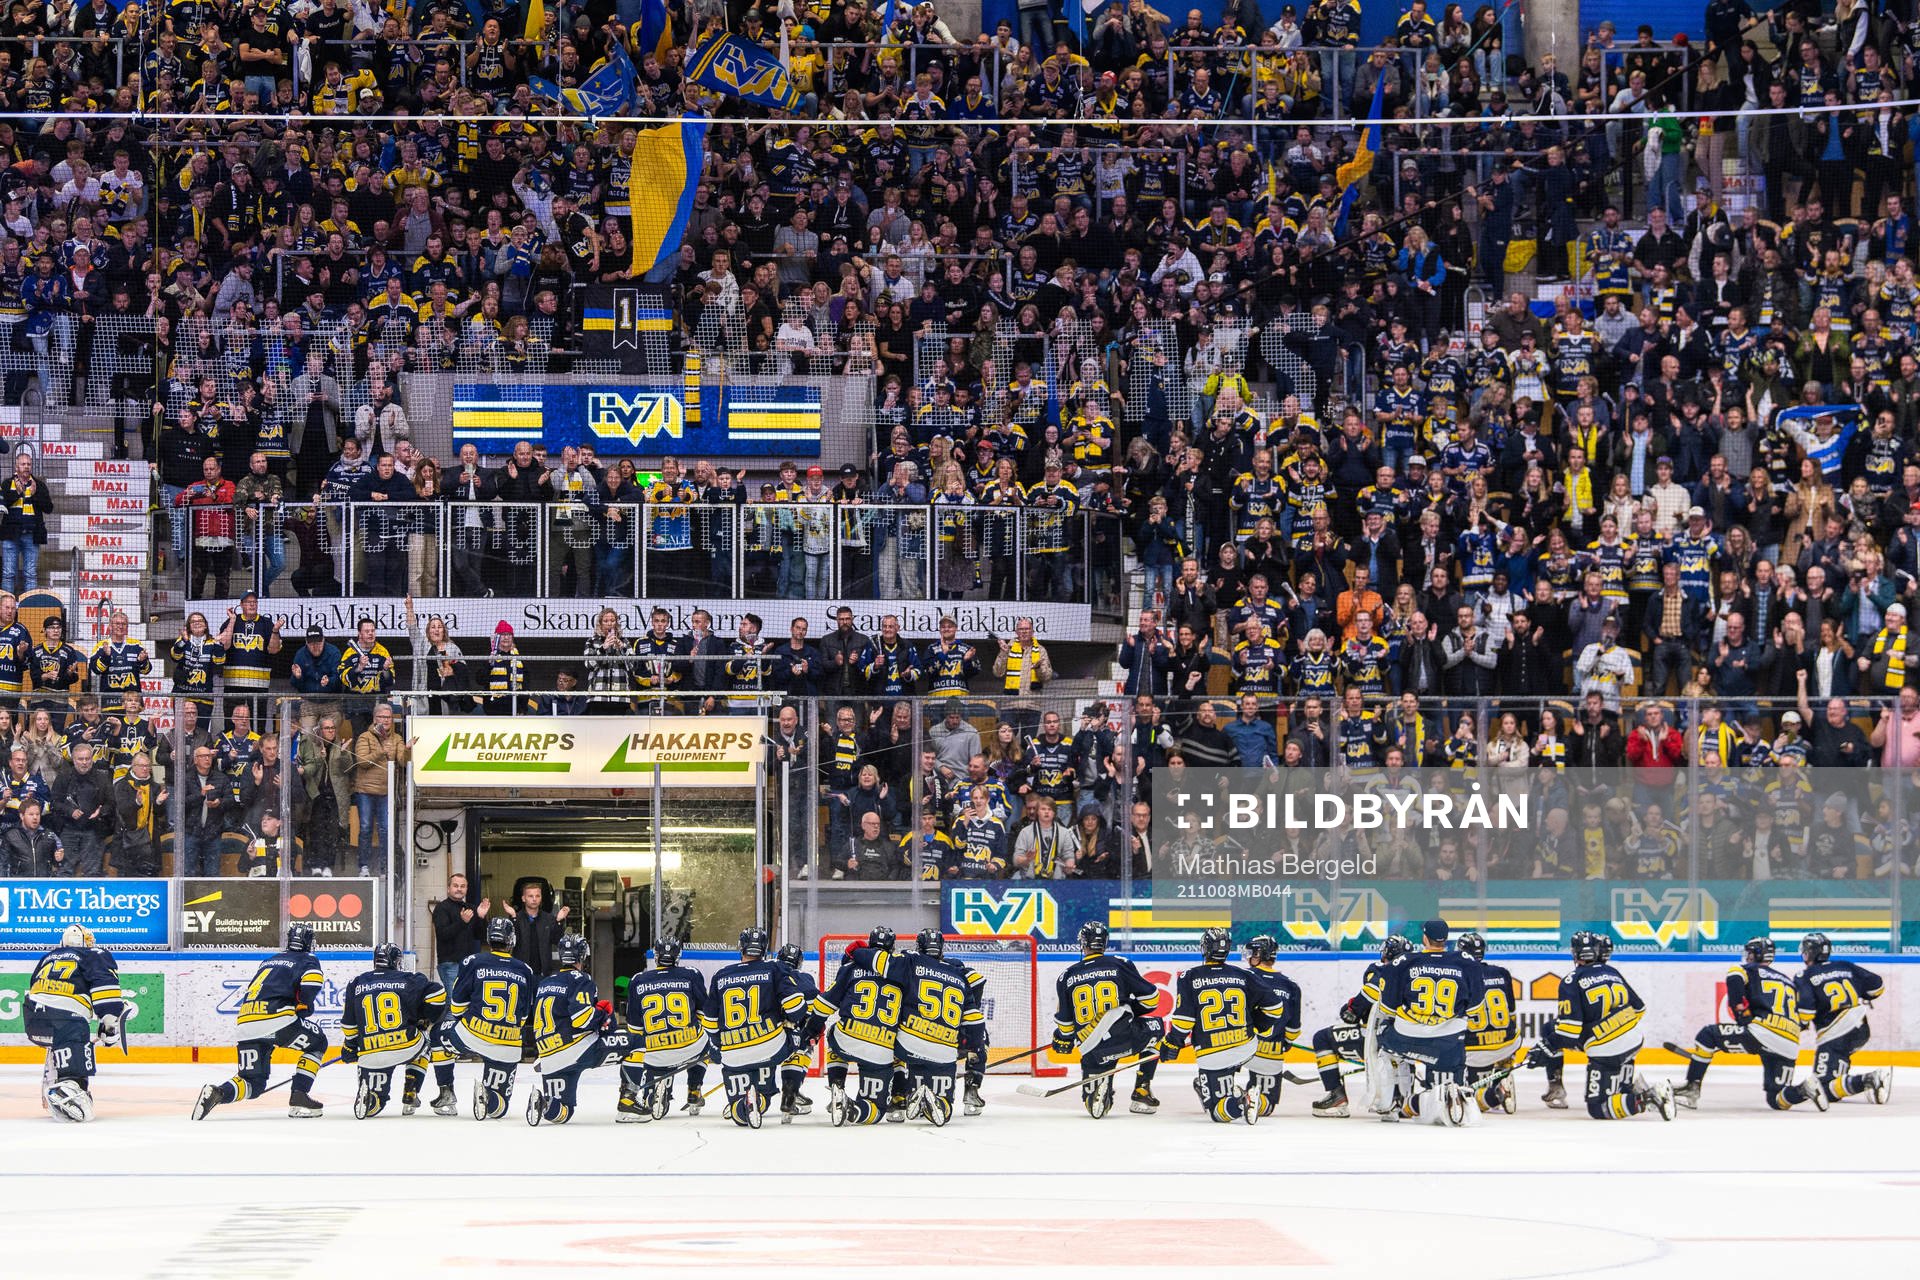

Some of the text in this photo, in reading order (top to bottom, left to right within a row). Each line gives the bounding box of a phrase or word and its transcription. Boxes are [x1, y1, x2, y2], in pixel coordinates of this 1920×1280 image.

[588, 392, 684, 448] HV71
[42, 443, 77, 455] MAXI
[94, 461, 130, 473] MAXI
[91, 479, 128, 492] MAXI
[106, 498, 143, 509] MAXI
[85, 535, 123, 546] MAXI
[101, 553, 139, 565] MAXI
[140, 680, 162, 691] AXI
[452, 732, 754, 750] HAKARPS HAKARPS
[477, 752, 727, 761] EQUIPMENT EQUIPMENT
[14, 887, 160, 917] TMG Tabergs
[183, 911, 215, 933] EY
[215, 919, 242, 927] Building
[215, 926, 242, 934] working
[683, 942, 727, 951] KONRADSSONS
[486, 969, 527, 984] Husqvarna
[724, 973, 769, 986] Husqvarna
[1073, 969, 1118, 984] Husqvarna
[1419, 967, 1463, 978] Husqvarna
[361, 982, 406, 992] Husqvarna
[645, 981, 691, 992] Husqvarna
[1202, 977, 1246, 987] Husqvarna
[481, 980, 519, 1023] 51
[576, 991, 591, 1005] 41
[851, 979, 903, 1027] 33
[917, 978, 965, 1029] 56
[1072, 980, 1120, 1026] 88
[1410, 976, 1458, 1018] 39
[1585, 983, 1629, 1020] 70
[362, 992, 403, 1034] 18
[641, 992, 691, 1034] 29
[722, 985, 763, 1029] 61
[1198, 987, 1247, 1032] 23
[363, 1029, 409, 1050] NYBECK
[238, 1049, 259, 1071] JP
[483, 1068, 508, 1090] JP
[859, 1076, 884, 1099] JP
